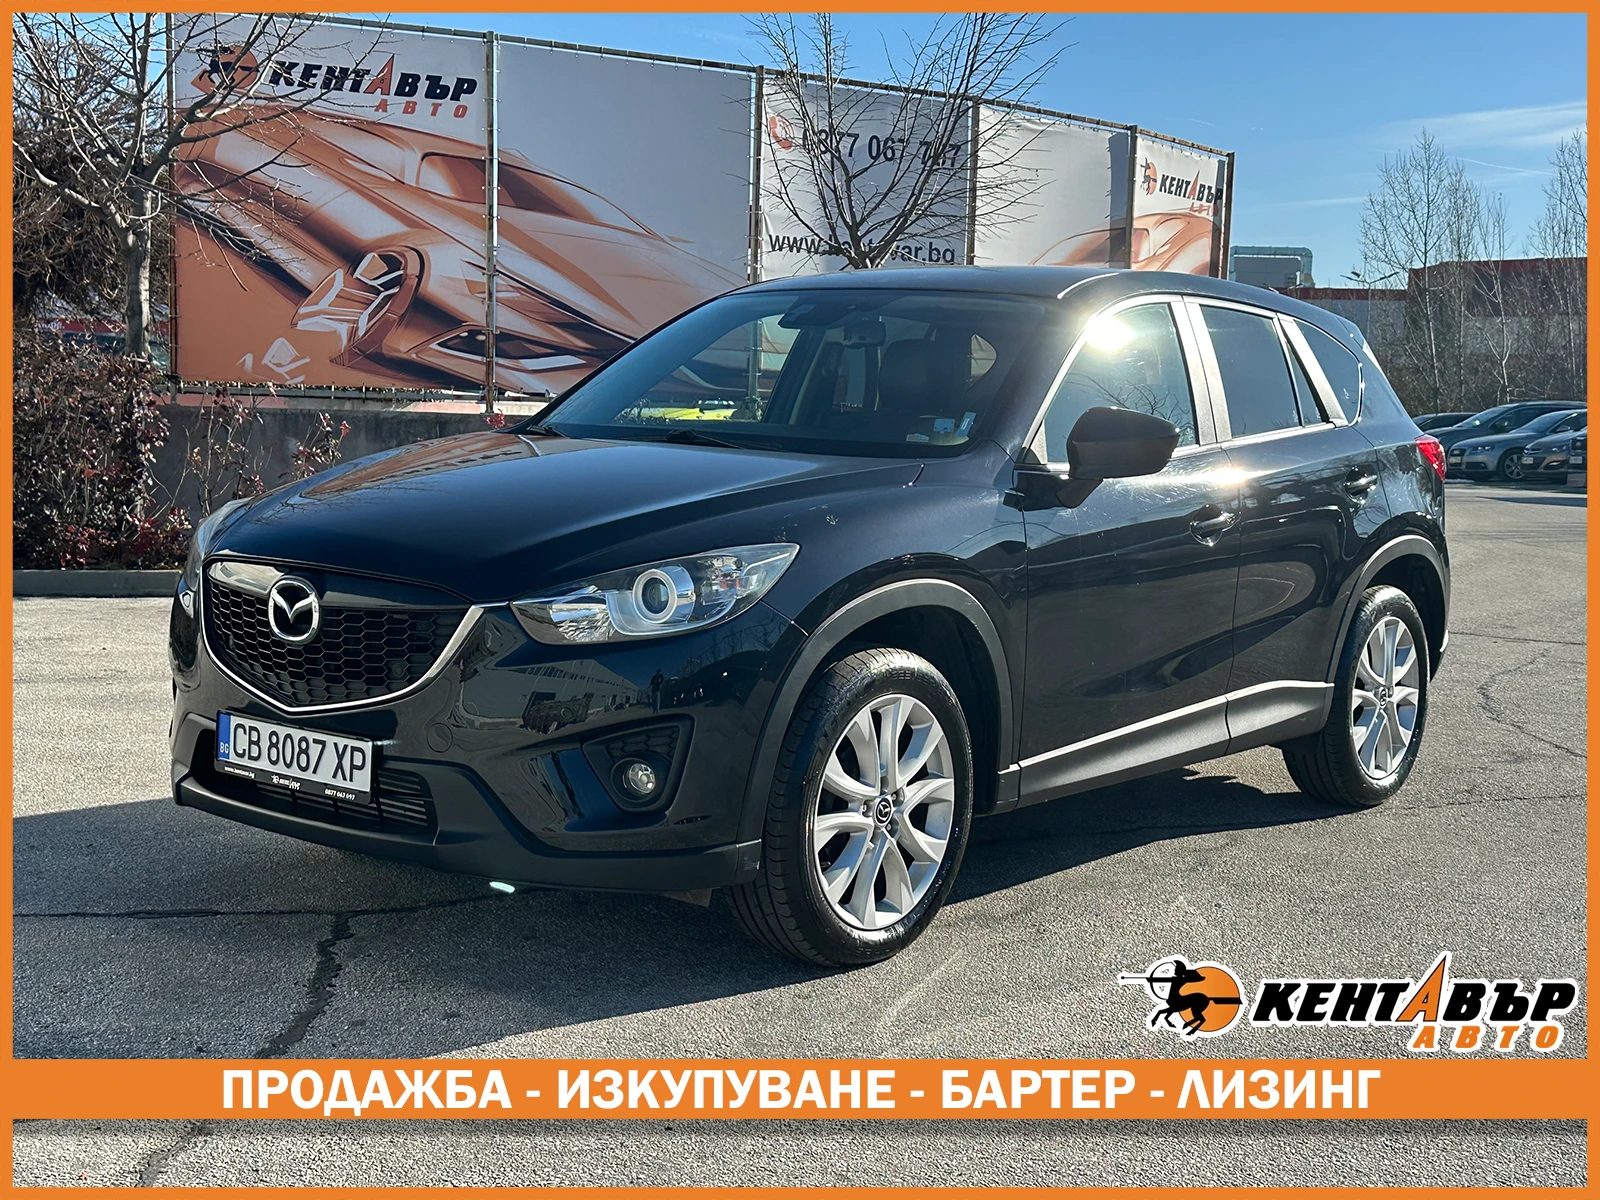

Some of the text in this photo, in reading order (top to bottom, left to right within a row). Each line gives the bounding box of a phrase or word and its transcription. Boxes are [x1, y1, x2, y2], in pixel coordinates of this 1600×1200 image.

[270, 54, 478, 101] КЕНТАВЪР
[375, 98, 469, 118] АВТО
[919, 140, 962, 168] 77
[1158, 170, 1224, 204] КЕНТАВЪР
[219, 742, 230, 754] BG
[233, 722, 366, 783] CB 8087 XP
